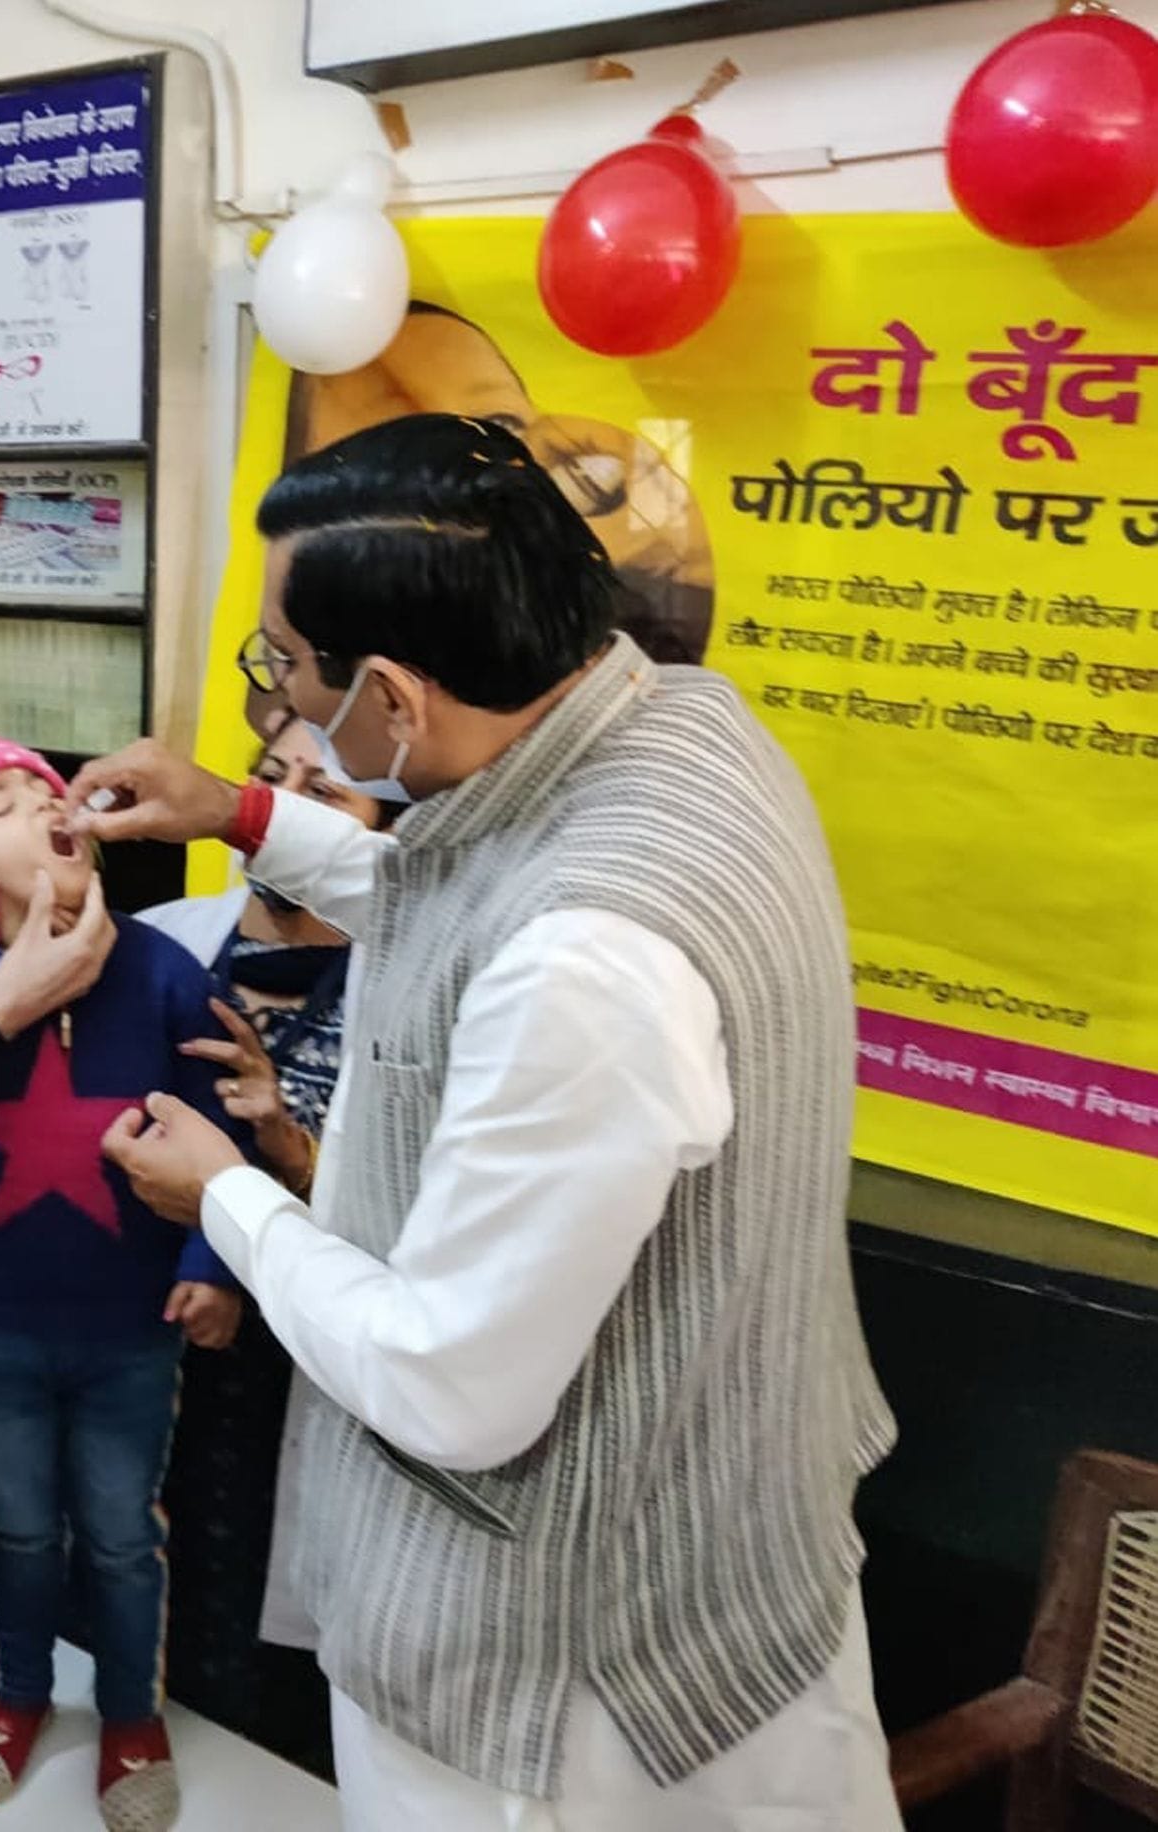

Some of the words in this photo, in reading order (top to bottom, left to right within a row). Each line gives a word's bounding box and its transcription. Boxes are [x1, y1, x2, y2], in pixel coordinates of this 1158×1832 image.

[810, 320, 936, 415] दो
[730, 458, 970, 536] पोलियो
[995, 489, 1105, 546] पर
[767, 574, 831, 602] भारत
[838, 574, 927, 612] पोलियो
[1045, 593, 1142, 634] लेकिन
[779, 628, 857, 660] सकता
[899, 638, 968, 672] अपने
[1038, 651, 1080, 685] की
[762, 684, 796, 709] हर
[799, 689, 843, 717] बार
[941, 702, 1037, 744] पोलियो
[1043, 722, 1086, 750] पर
